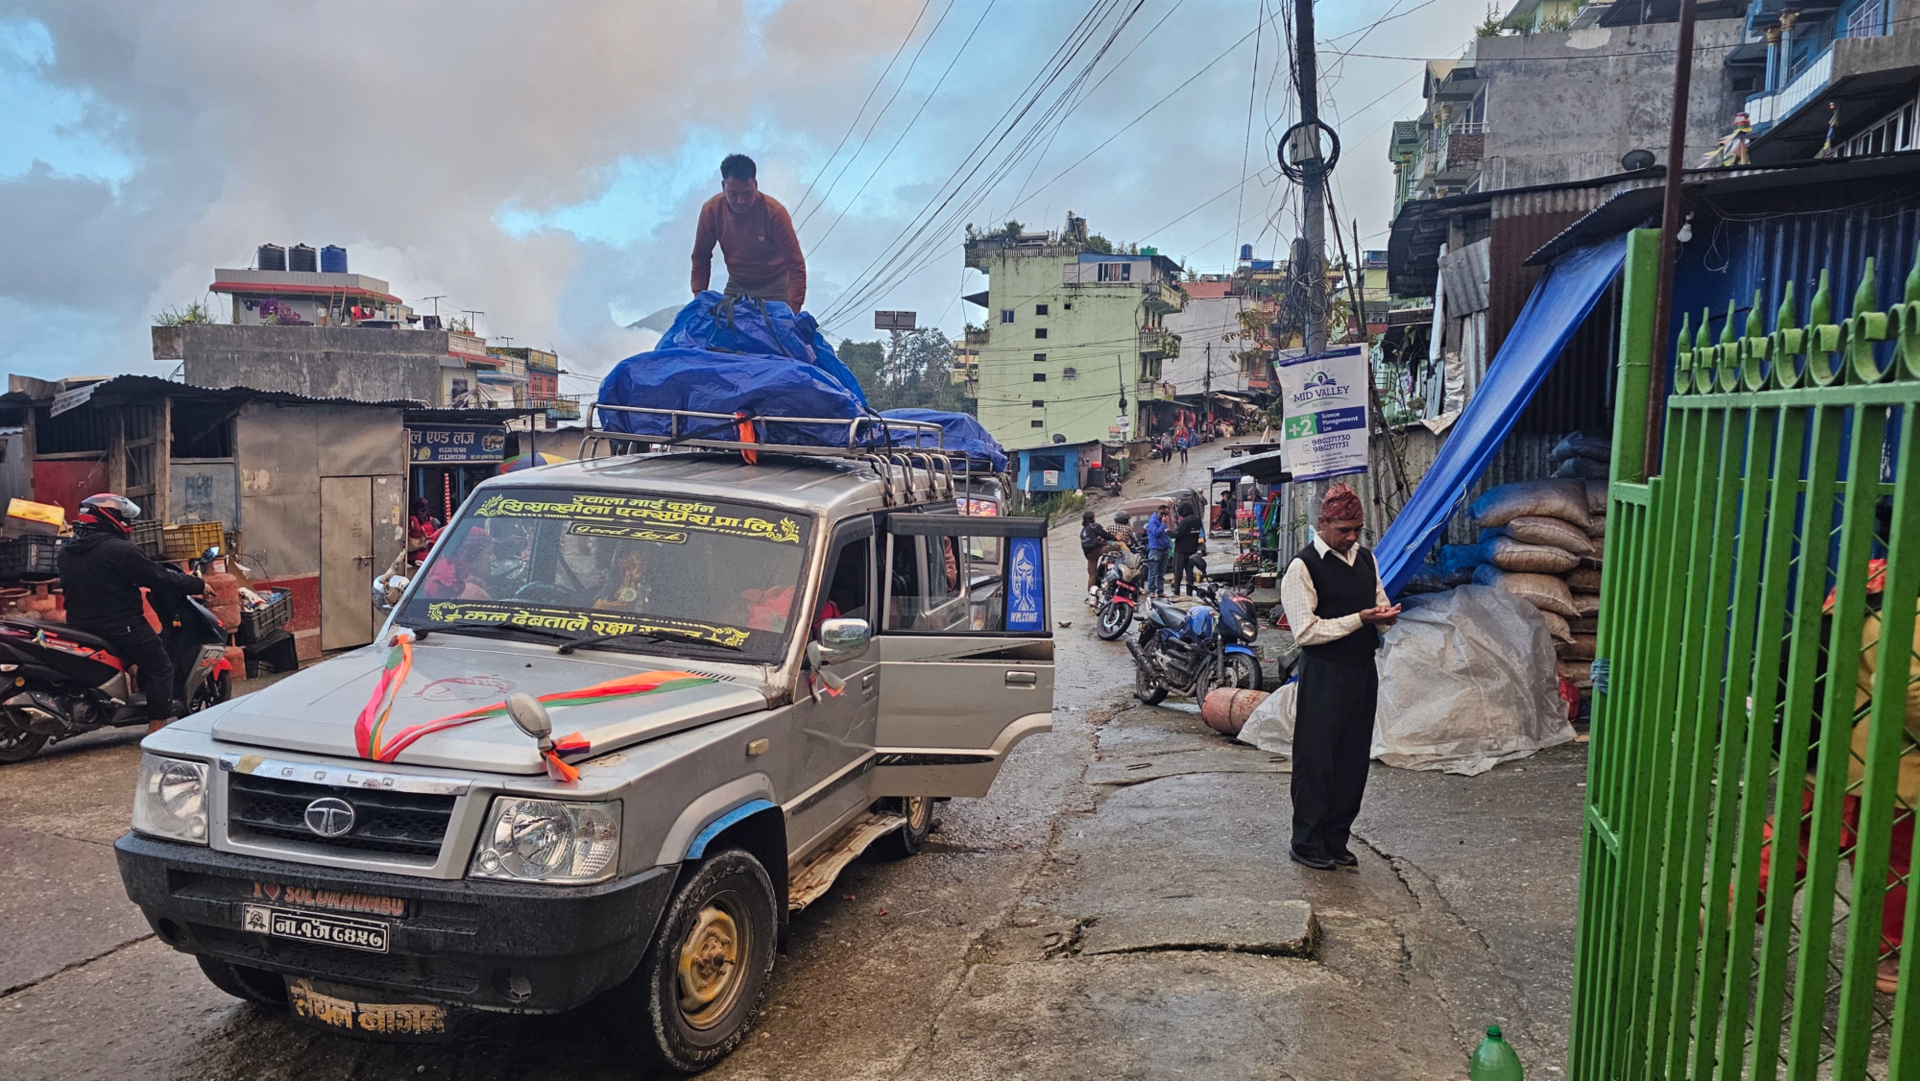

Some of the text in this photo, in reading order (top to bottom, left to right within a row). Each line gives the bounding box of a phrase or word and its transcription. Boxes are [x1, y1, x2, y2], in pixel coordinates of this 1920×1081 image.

[1293, 385, 1350, 403] MID VALLEY
[1321, 412, 1341, 420] Science
[1322, 415, 1359, 425] Management
[1289, 418, 1314, 437] +2
[576, 525, 630, 536] Good
[1010, 611, 1039, 623] WELCOME
[253, 881, 404, 917] I SOLUKHUMBU
